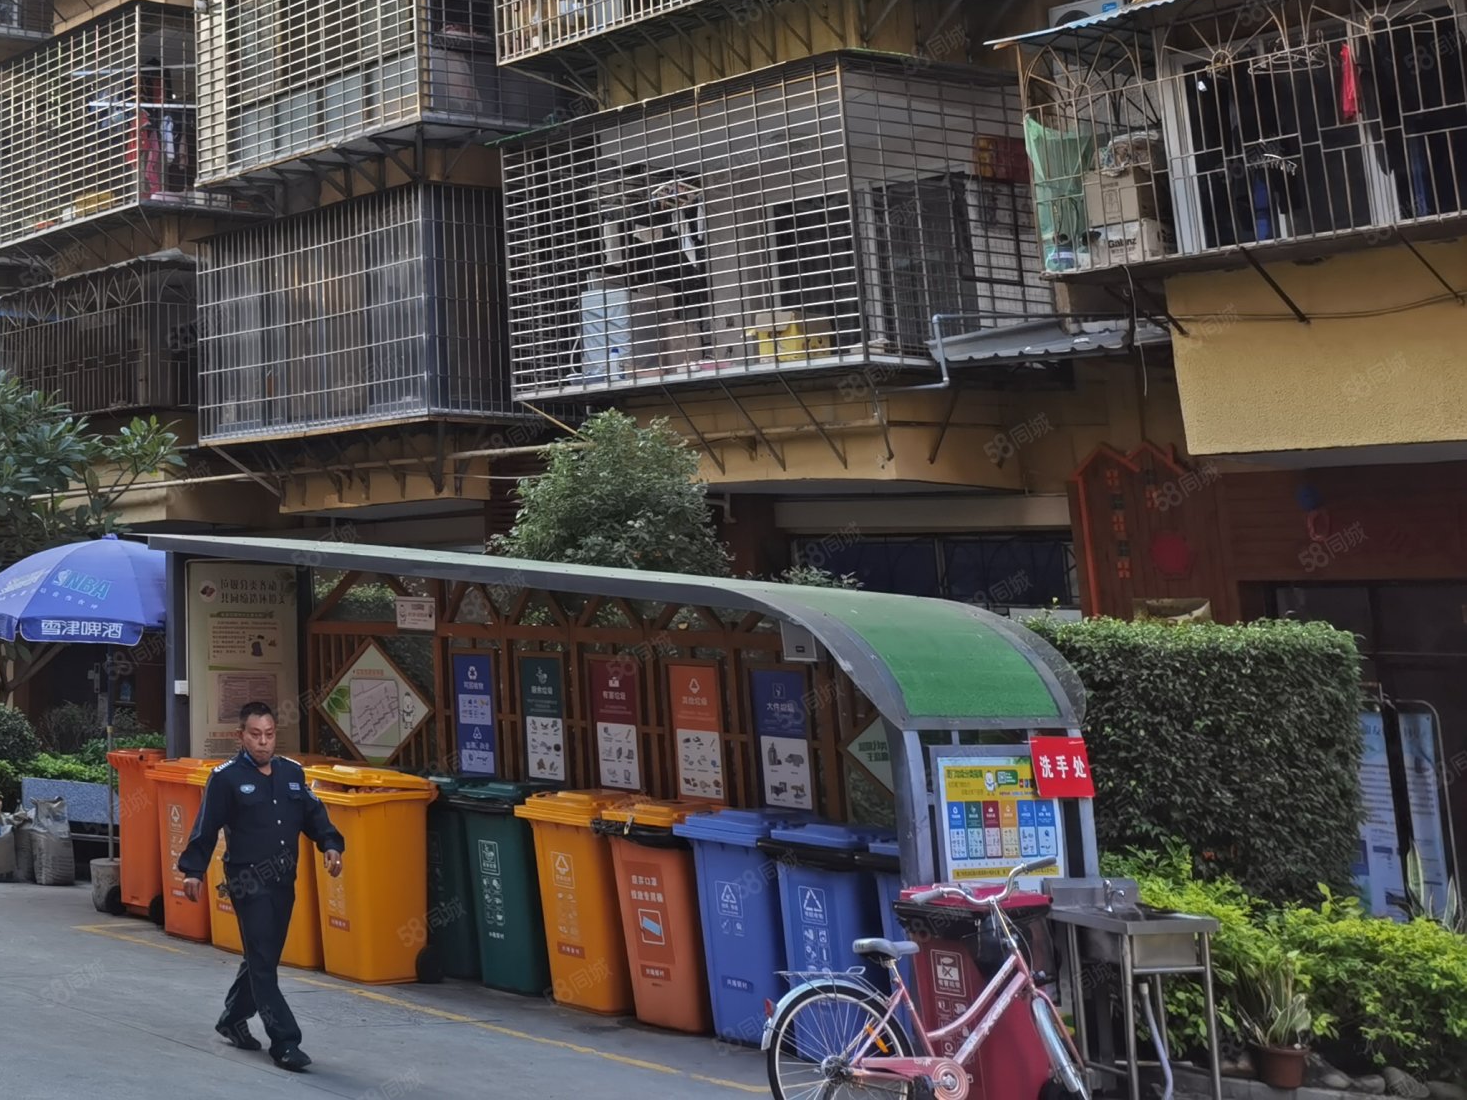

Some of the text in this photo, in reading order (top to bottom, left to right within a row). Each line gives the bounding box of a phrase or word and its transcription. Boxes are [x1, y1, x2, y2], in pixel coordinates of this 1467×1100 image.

[1108, 237, 1137, 249] Galnz
[41, 619, 123, 639] 雪津啤酒
[1039, 755, 1087, 779] 洗手处
